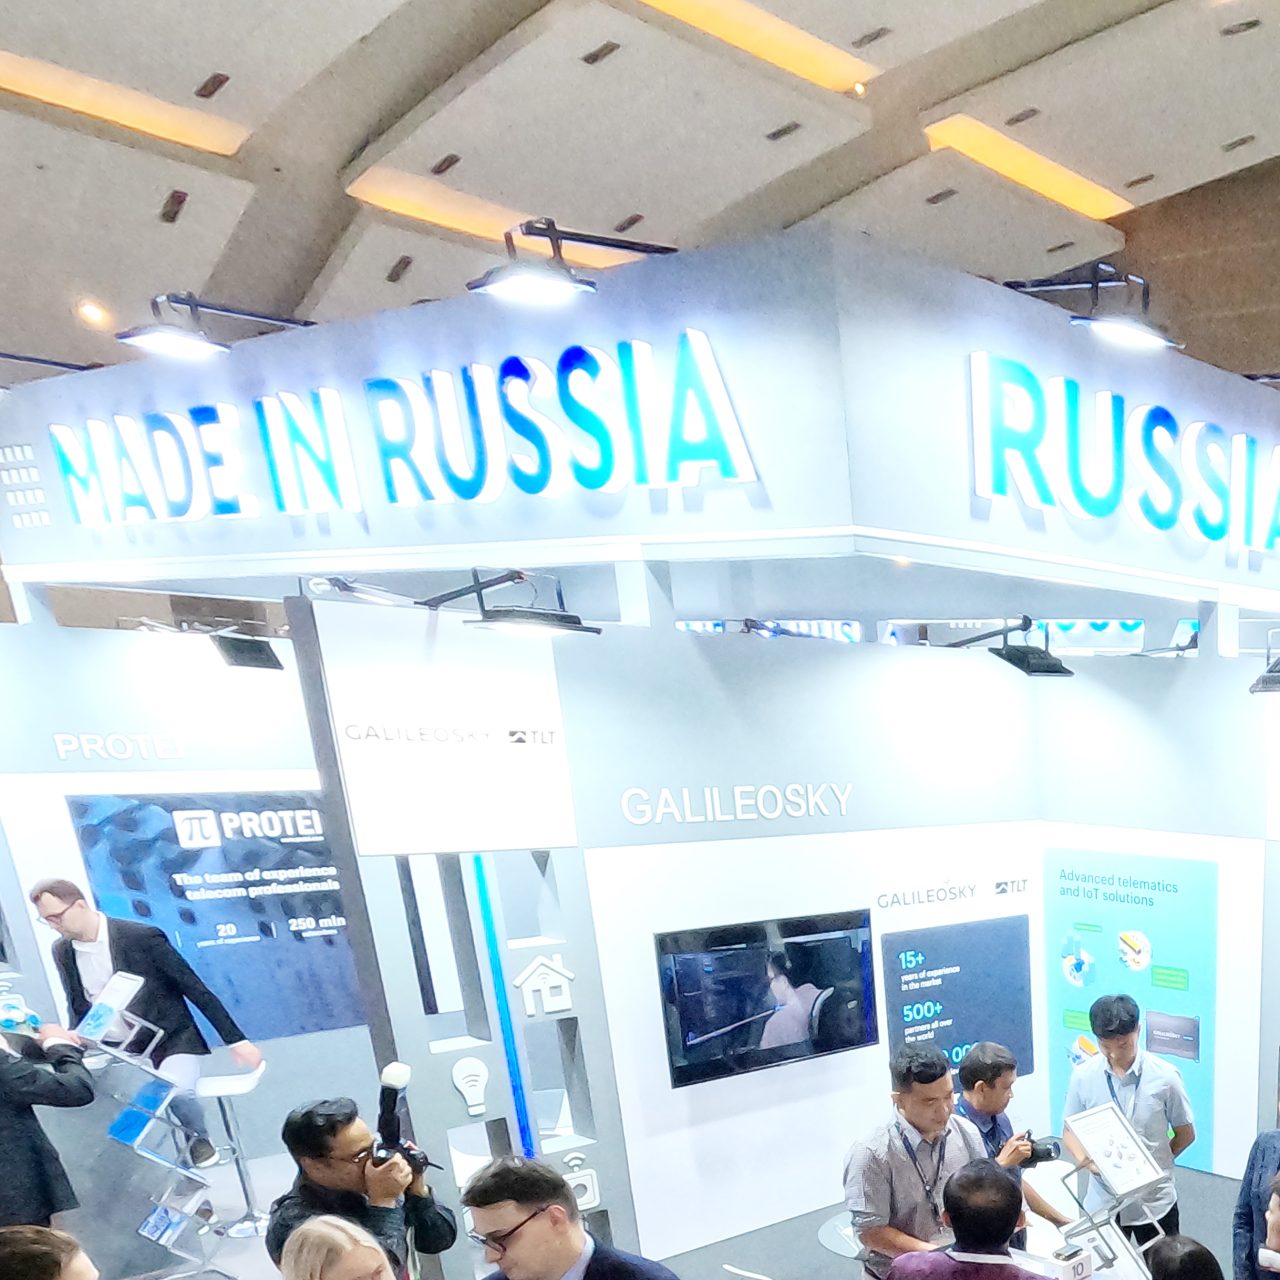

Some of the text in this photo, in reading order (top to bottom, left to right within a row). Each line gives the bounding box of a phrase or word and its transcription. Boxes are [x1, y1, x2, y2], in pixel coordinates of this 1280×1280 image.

[48, 327, 757, 525] MADE IN RUSSIA
[345, 724, 556, 744] GALILEOSKY TLT
[620, 783, 853, 825] GALILEOSKY
[219, 809, 323, 839] PROTEI
[171, 866, 338, 886] The team of experience
[1059, 869, 1179, 893] Advanced telematics
[248, 879, 341, 899] professionals
[877, 879, 1028, 909] GALILEOSKY TLT
[1059, 885, 1155, 907] and IoT solutions
[215, 923, 237, 937] 20
[287, 917, 317, 931] 250
[898, 951, 925, 970] 15+
[901, 971, 918, 982] years
[927, 965, 961, 978] experience
[909, 981, 919, 990] the
[903, 1001, 943, 1022] 500+
[904, 1022, 931, 1035] partners
[939, 1018, 953, 1027] over
[905, 1031, 934, 1044] the world
[1071, 1262, 1084, 1278] 10
